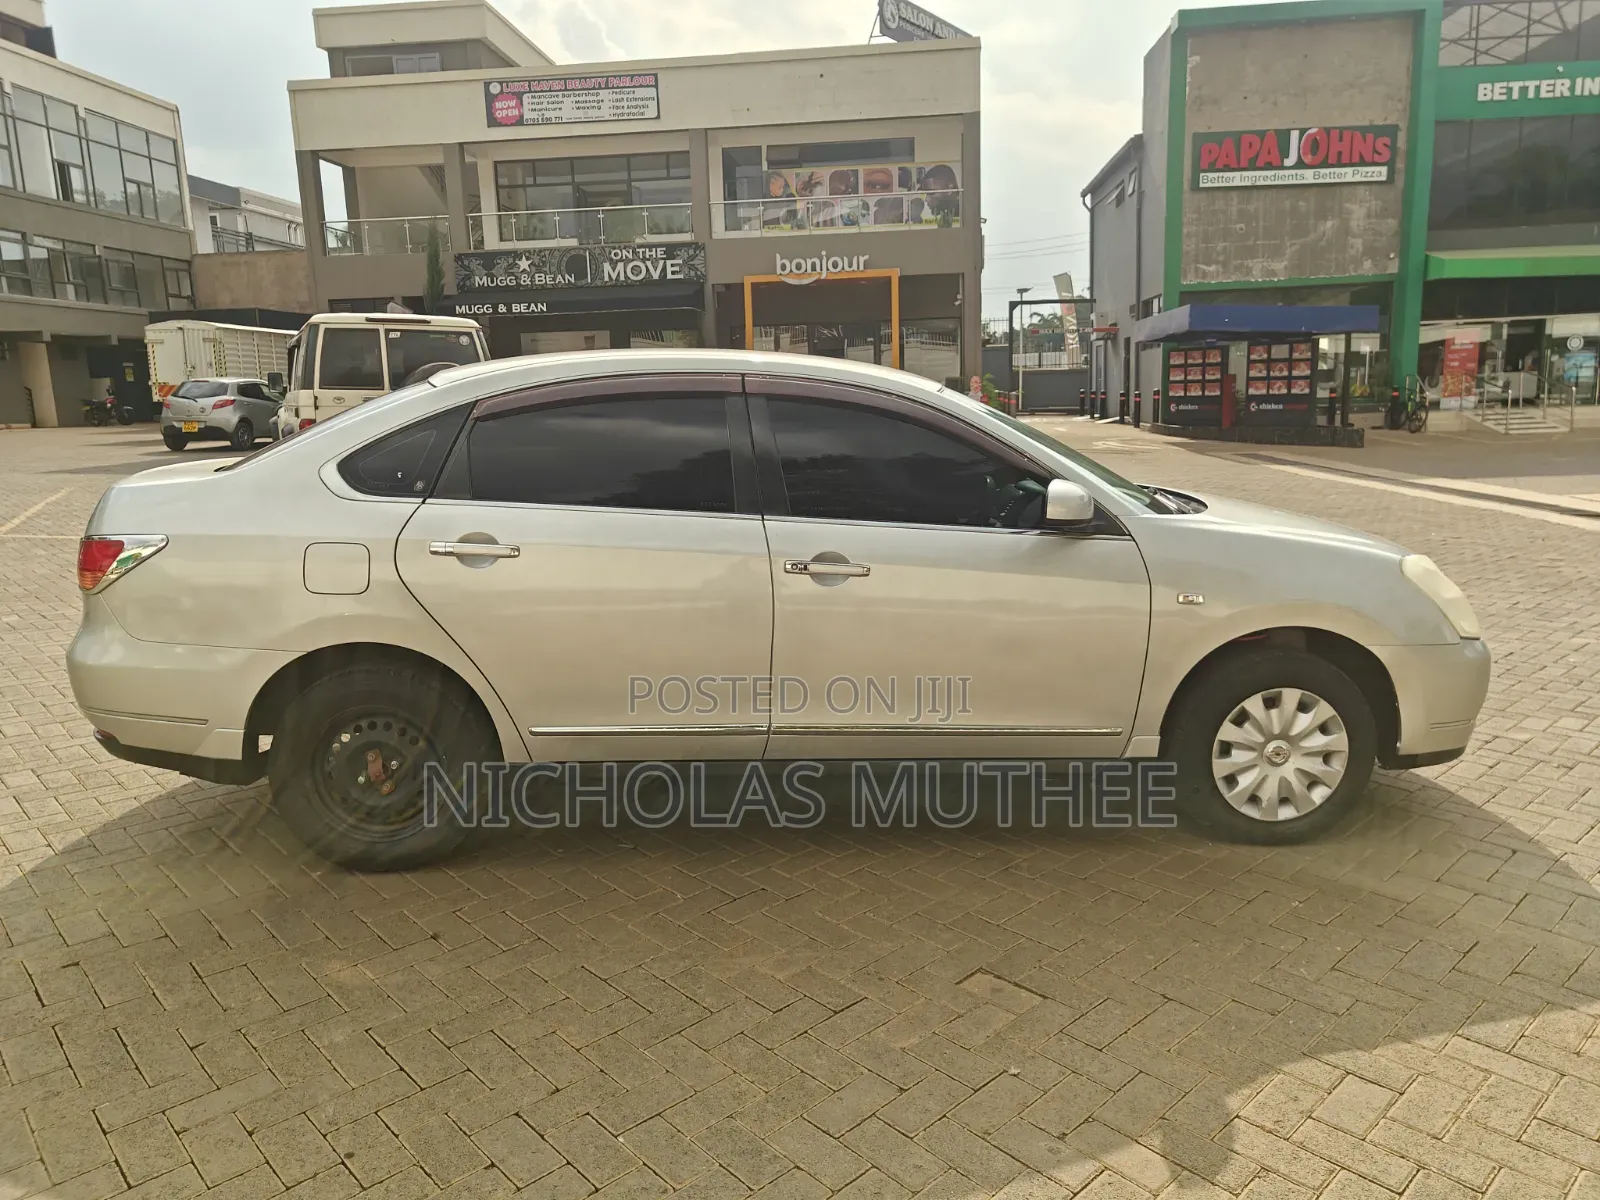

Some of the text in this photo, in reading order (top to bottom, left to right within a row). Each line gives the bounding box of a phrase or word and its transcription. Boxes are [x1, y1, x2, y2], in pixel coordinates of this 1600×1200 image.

[899, 2, 933, 32] SALON
[502, 76, 655, 92] LUXE HAVEN BEAUTY PARLOUR
[1477, 78, 1571, 101] BETTER
[561, 91, 601, 99] Barbershop
[495, 100, 516, 109] NOW
[495, 109, 519, 117] OPEN
[1200, 131, 1281, 169] PAPA
[1201, 167, 1386, 185] Better Ingredients. Better Pizza.
[611, 247, 666, 260] ON THE
[603, 259, 684, 282] MOVE
[776, 251, 869, 279] bonjour
[520, 274, 531, 286] &
[455, 302, 547, 315] MUGG & BEAN
[1259, 402, 1283, 410] chicken
